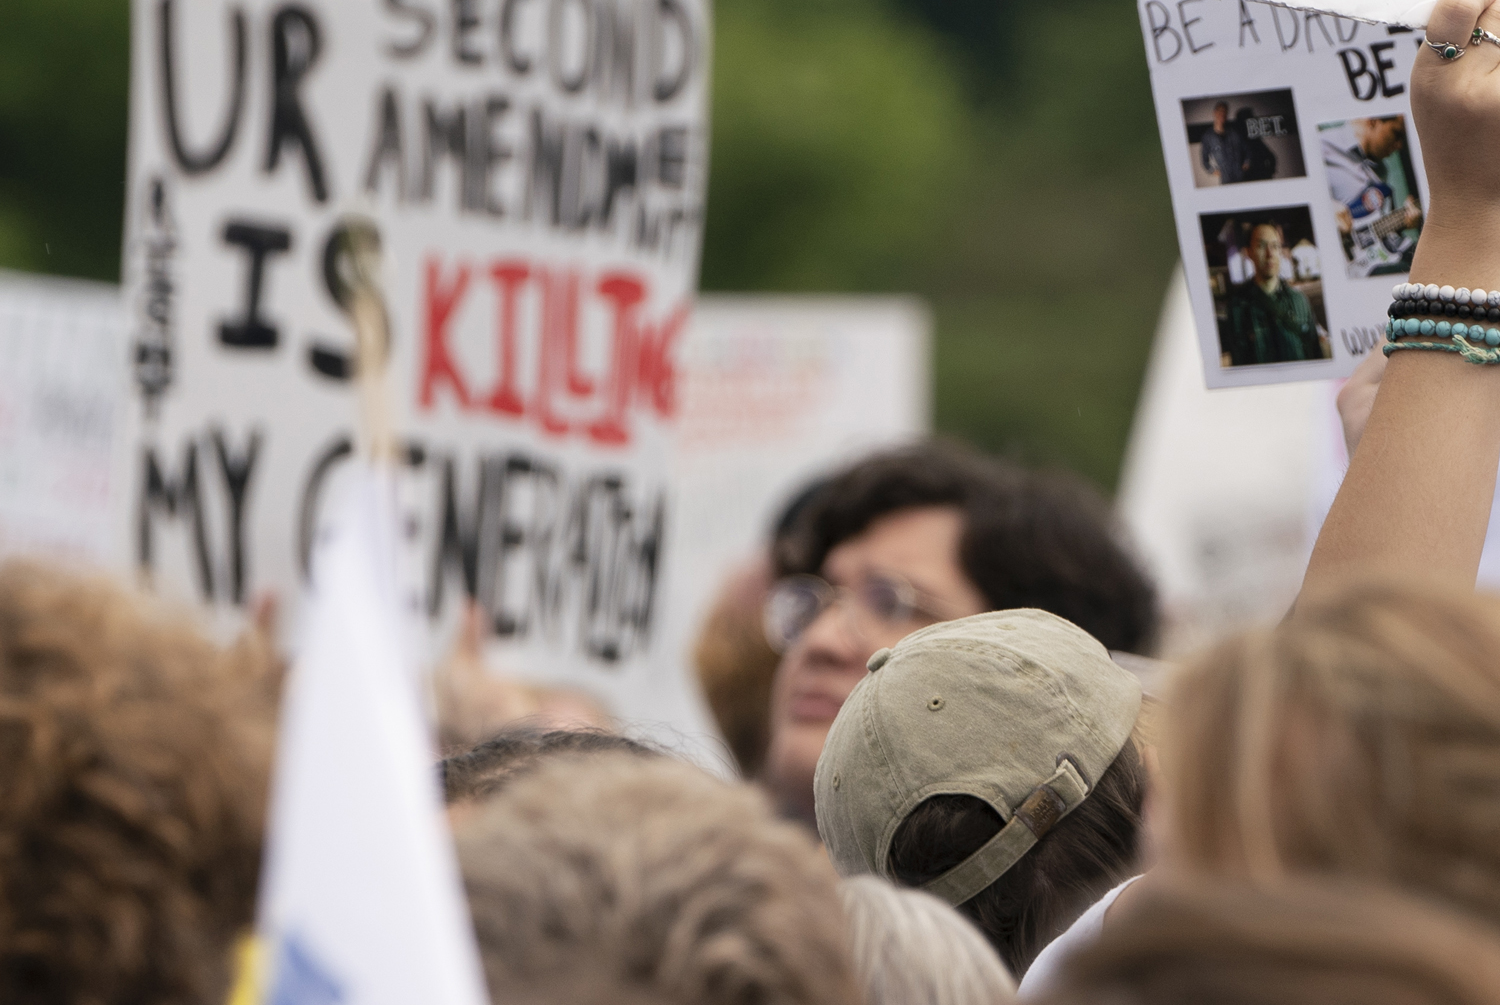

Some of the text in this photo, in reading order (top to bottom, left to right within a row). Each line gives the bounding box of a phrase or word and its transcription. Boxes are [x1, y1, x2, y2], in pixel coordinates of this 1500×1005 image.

[1236, 0, 1262, 46] A
[1337, 40, 1406, 102] BE
[217, 202, 392, 384] IS
[138, 428, 263, 602] MY
